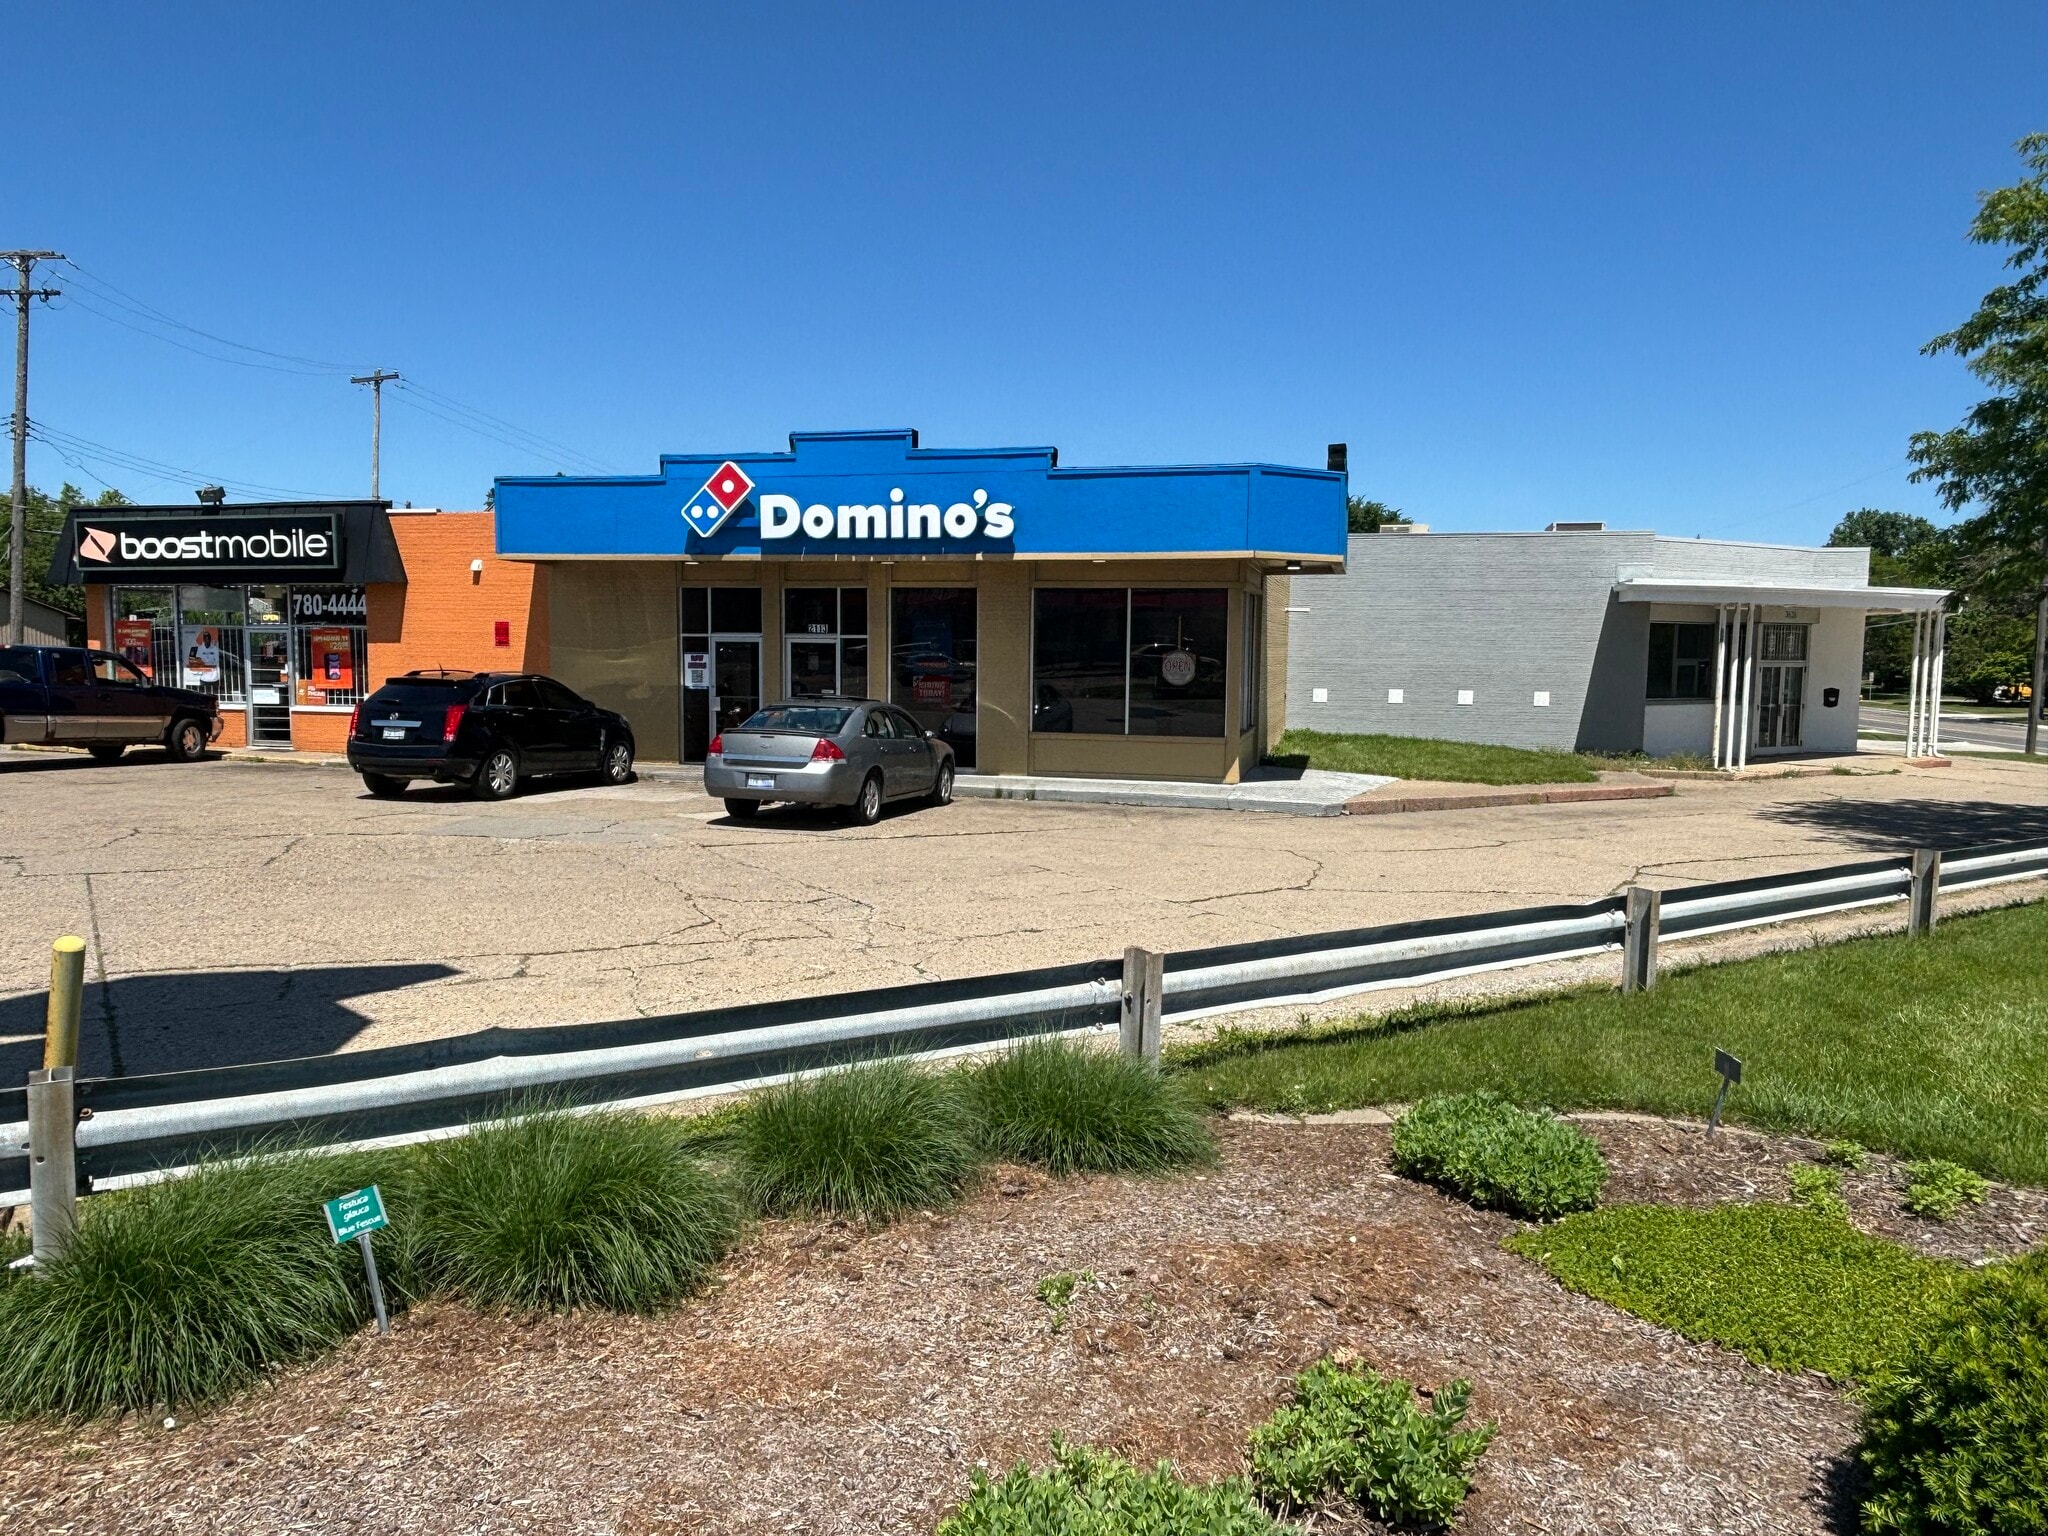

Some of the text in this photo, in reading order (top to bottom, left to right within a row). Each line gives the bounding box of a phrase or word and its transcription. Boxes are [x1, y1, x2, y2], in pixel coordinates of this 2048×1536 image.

[759, 487, 1015, 540] Domino's
[292, 594, 367, 616] 780-4444
[1164, 660, 1191, 672] OPEN
[338, 1195, 369, 1211] Festuca
[343, 1205, 370, 1223] glauca
[337, 1215, 382, 1236] Blue Fescue
